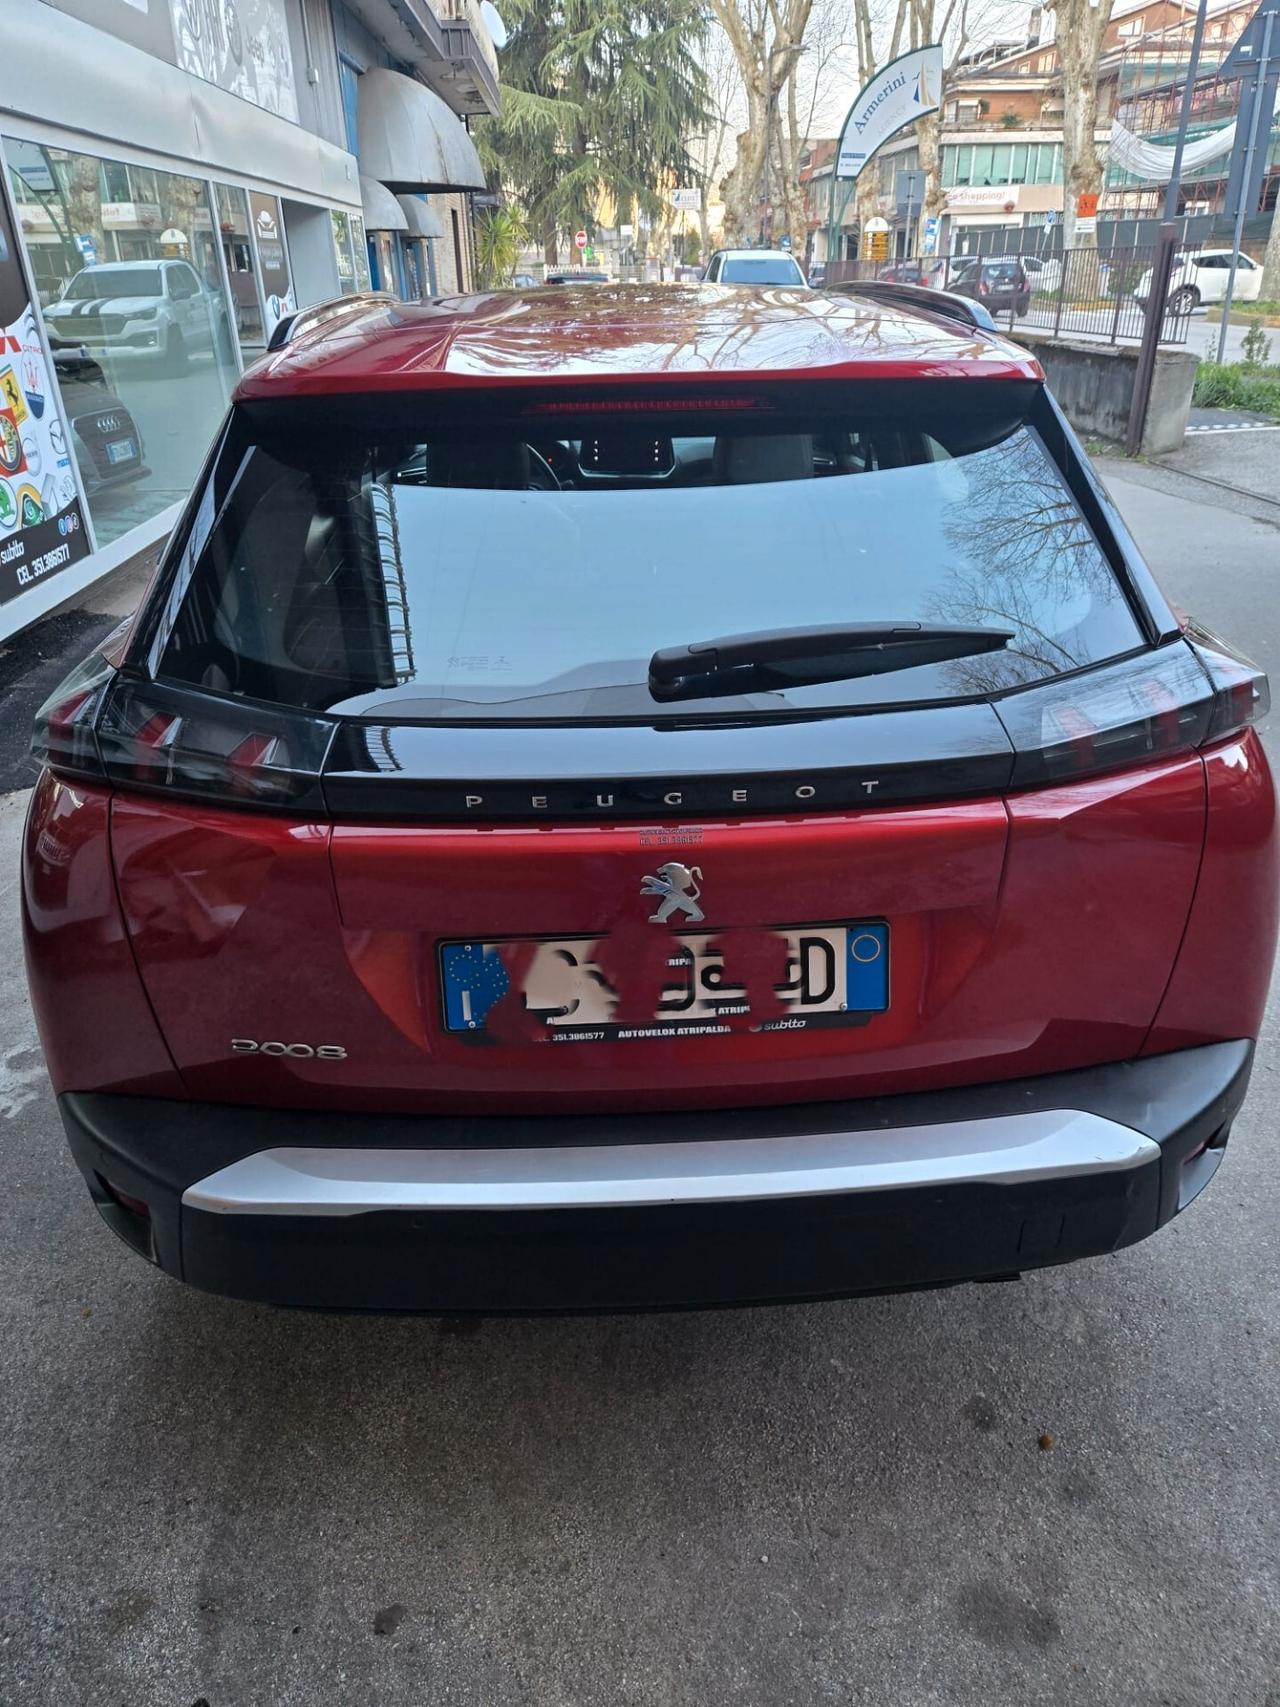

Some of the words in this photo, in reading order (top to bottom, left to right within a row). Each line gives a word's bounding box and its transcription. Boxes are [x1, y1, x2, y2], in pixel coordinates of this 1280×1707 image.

[854, 72, 907, 135] Armerini
[0, 539, 25, 564] subito
[16, 564, 34, 585] CEL.
[465, 780, 879, 809] PEUGEOT
[617, 1028, 675, 1038] AUTOVELOX
[676, 1025, 732, 1036] ATRIPALDA
[763, 1018, 807, 1031] subito
[231, 1038, 348, 1060] 2008
